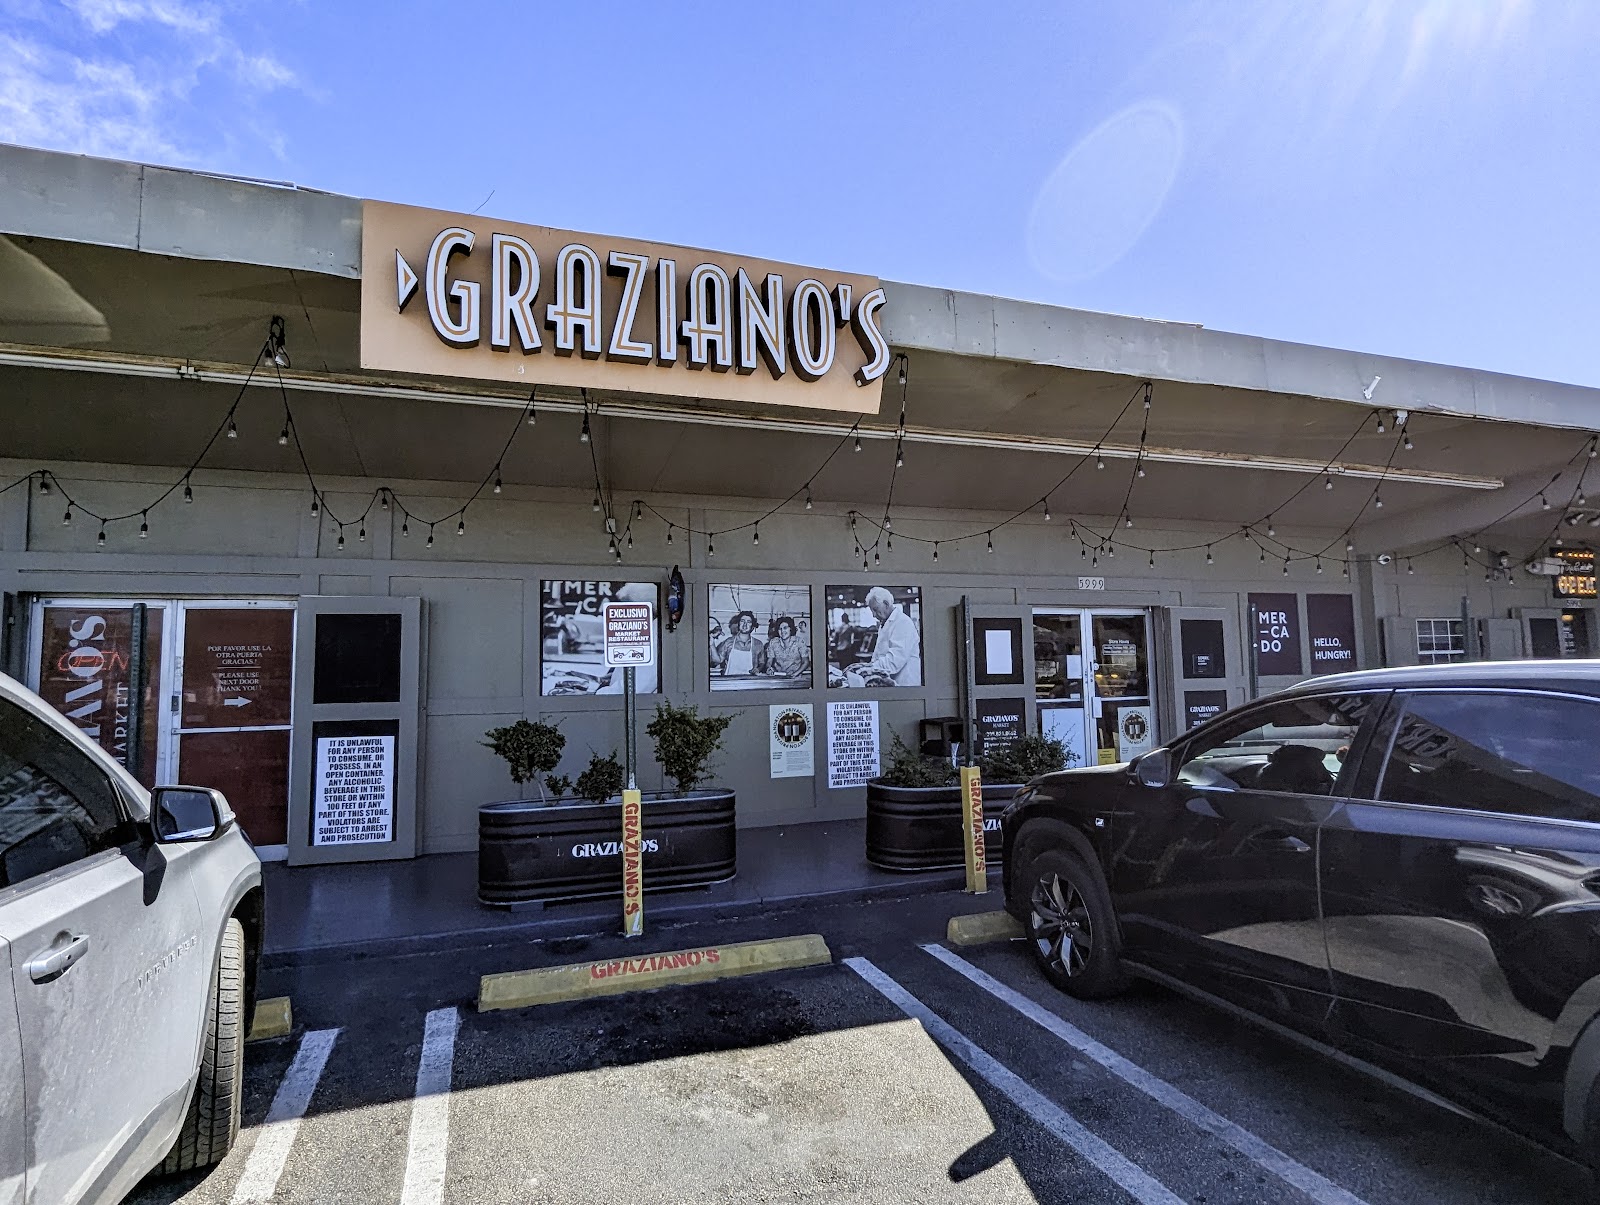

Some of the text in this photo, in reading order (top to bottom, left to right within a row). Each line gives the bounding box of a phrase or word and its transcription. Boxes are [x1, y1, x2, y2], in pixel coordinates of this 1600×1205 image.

[425, 226, 890, 386] GRAZIANO'S
[564, 580, 612, 596] MER
[1080, 579, 1104, 589] 5999
[610, 608, 647, 618] EXCLUSIVO
[1258, 612, 1288, 624] MER
[609, 621, 648, 630] GRAZIANO'S
[1261, 640, 1282, 652] DO
[1314, 638, 1342, 647] HELLO,
[1315, 650, 1352, 660] HUNGRY!
[57, 652, 130, 671] OPEN
[328, 818, 365, 826] VIOLATORS
[971, 778, 986, 872] GRAZIANO'S
[319, 827, 349, 835] SUBJECT
[361, 824, 388, 832] ARREST
[337, 832, 386, 841] PROSECUTION
[572, 839, 658, 858] GRAZIAO'S
[625, 802, 640, 916] GRAZIANO'S
[591, 949, 720, 979] GRAZIANO'S
